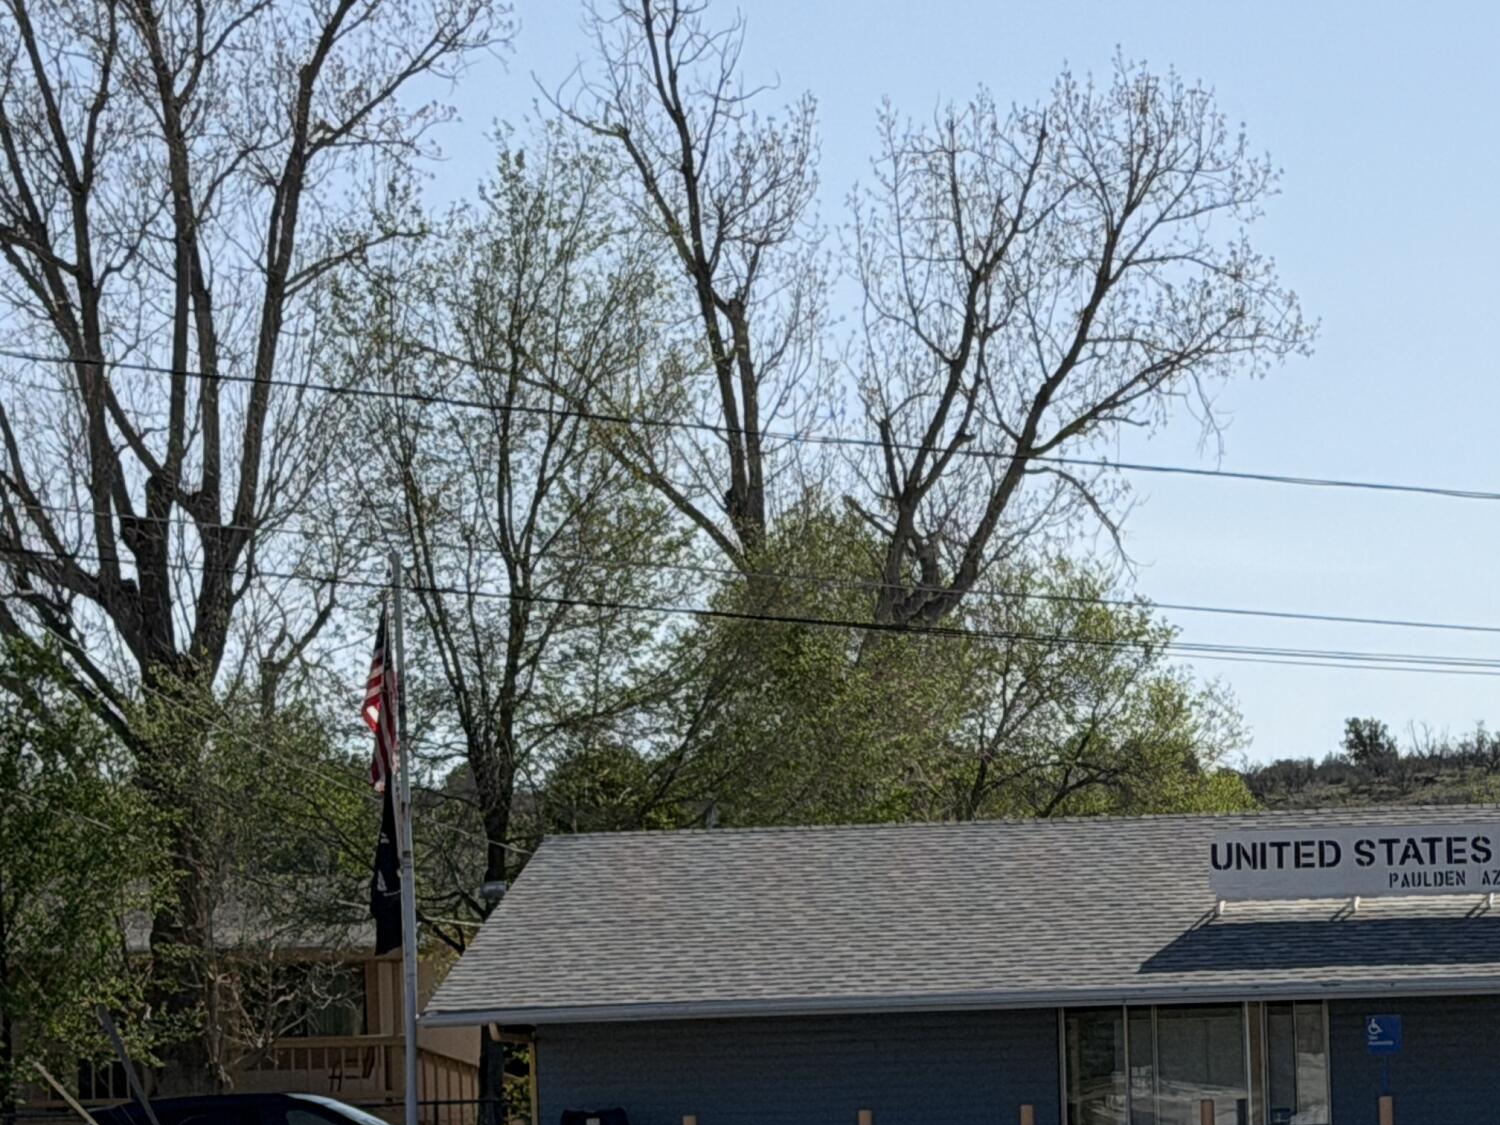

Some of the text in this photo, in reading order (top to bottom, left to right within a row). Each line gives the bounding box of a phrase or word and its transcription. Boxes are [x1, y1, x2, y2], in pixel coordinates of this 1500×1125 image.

[1210, 840, 1342, 871] UNITED
[1353, 835, 1493, 868] STATES
[1387, 868, 1467, 889] PAULDEN
